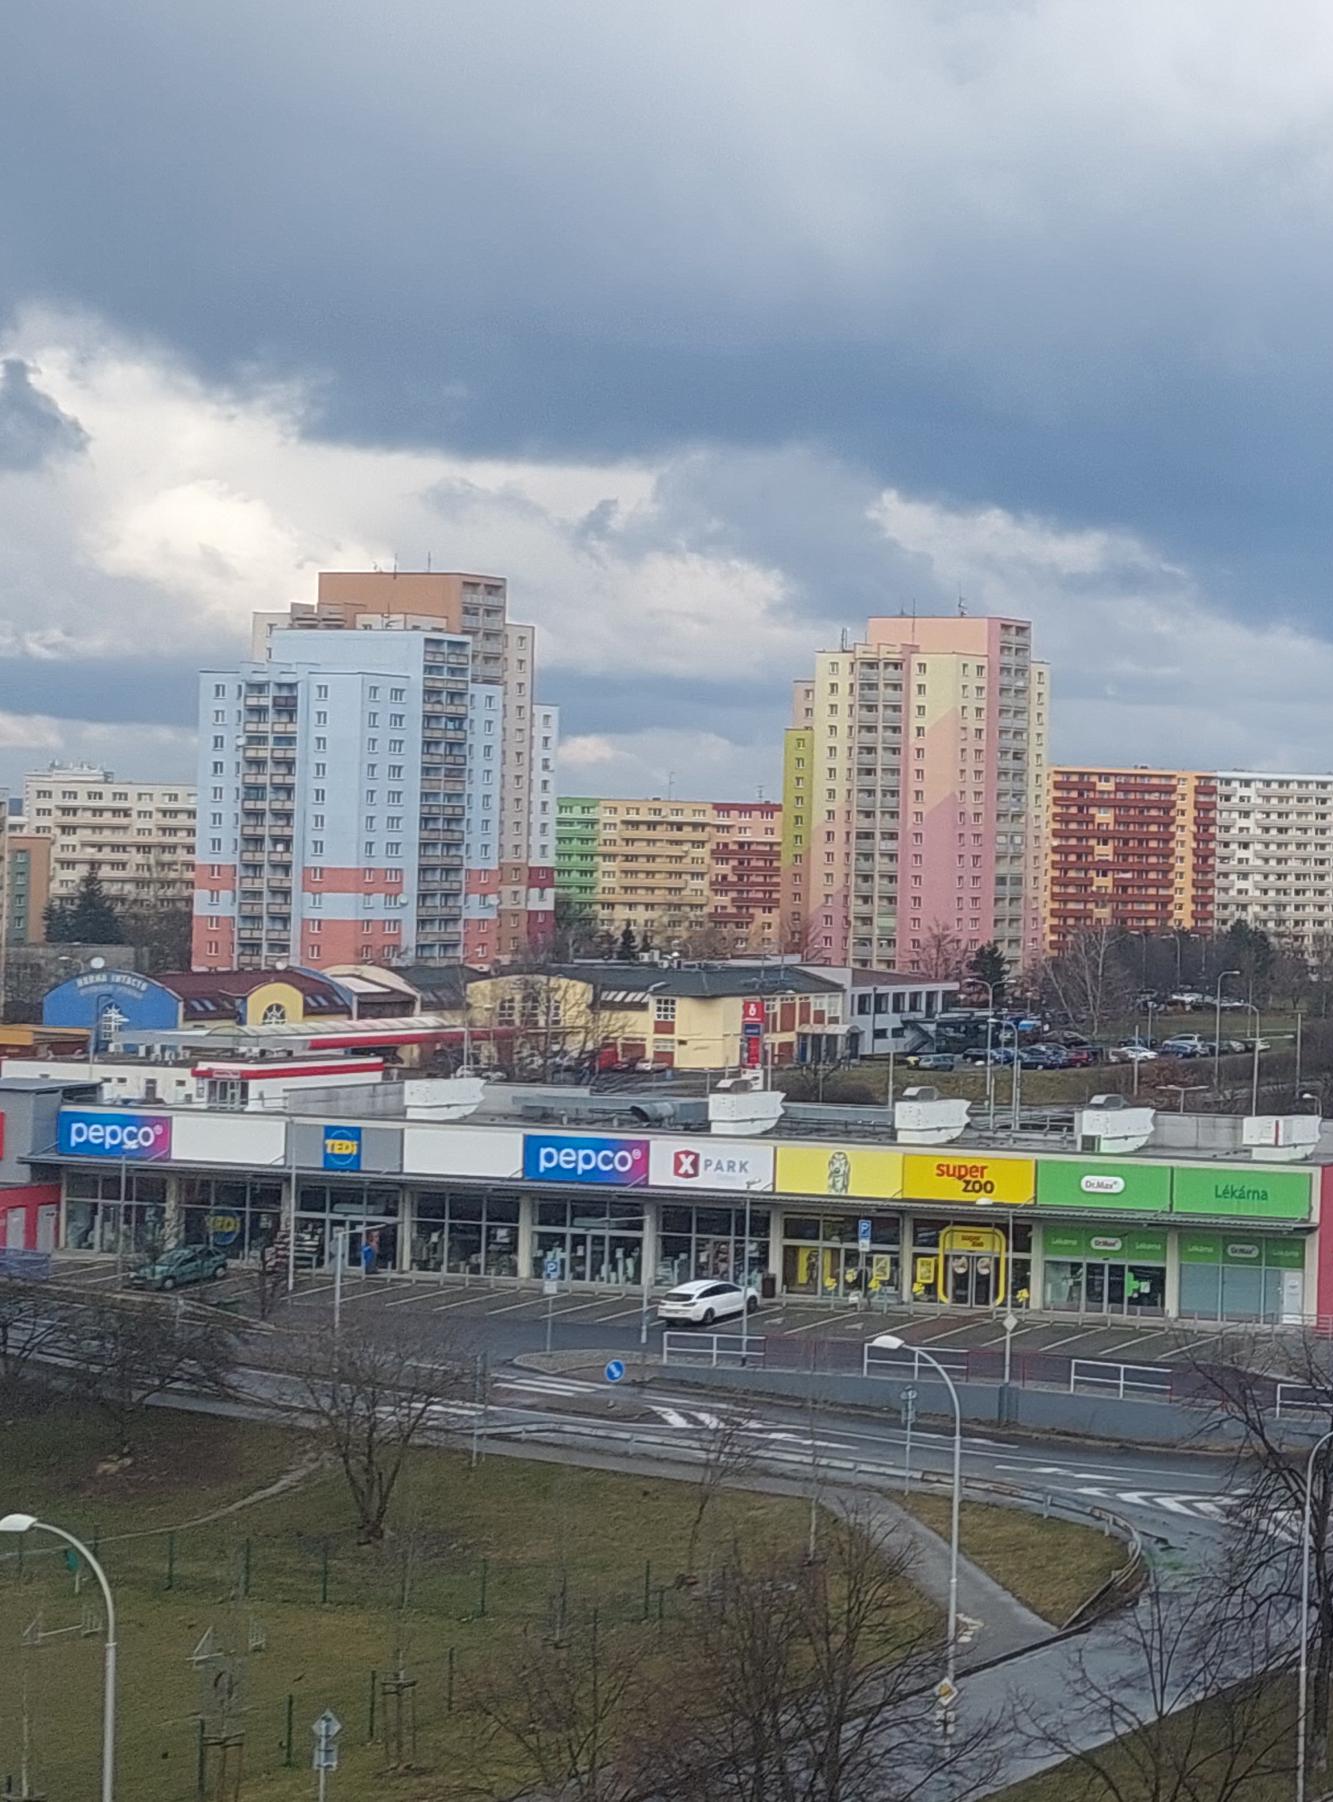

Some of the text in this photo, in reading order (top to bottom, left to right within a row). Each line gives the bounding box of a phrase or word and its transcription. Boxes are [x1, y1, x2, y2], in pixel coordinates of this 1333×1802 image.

[70, 1122, 155, 1149] pepco
[539, 1147, 632, 1175] pepco
[678, 1153, 749, 1174] X PARK
[936, 1163, 989, 1180] super
[962, 1180, 995, 1194] zoo
[1215, 1184, 1268, 1200] Lékárna
